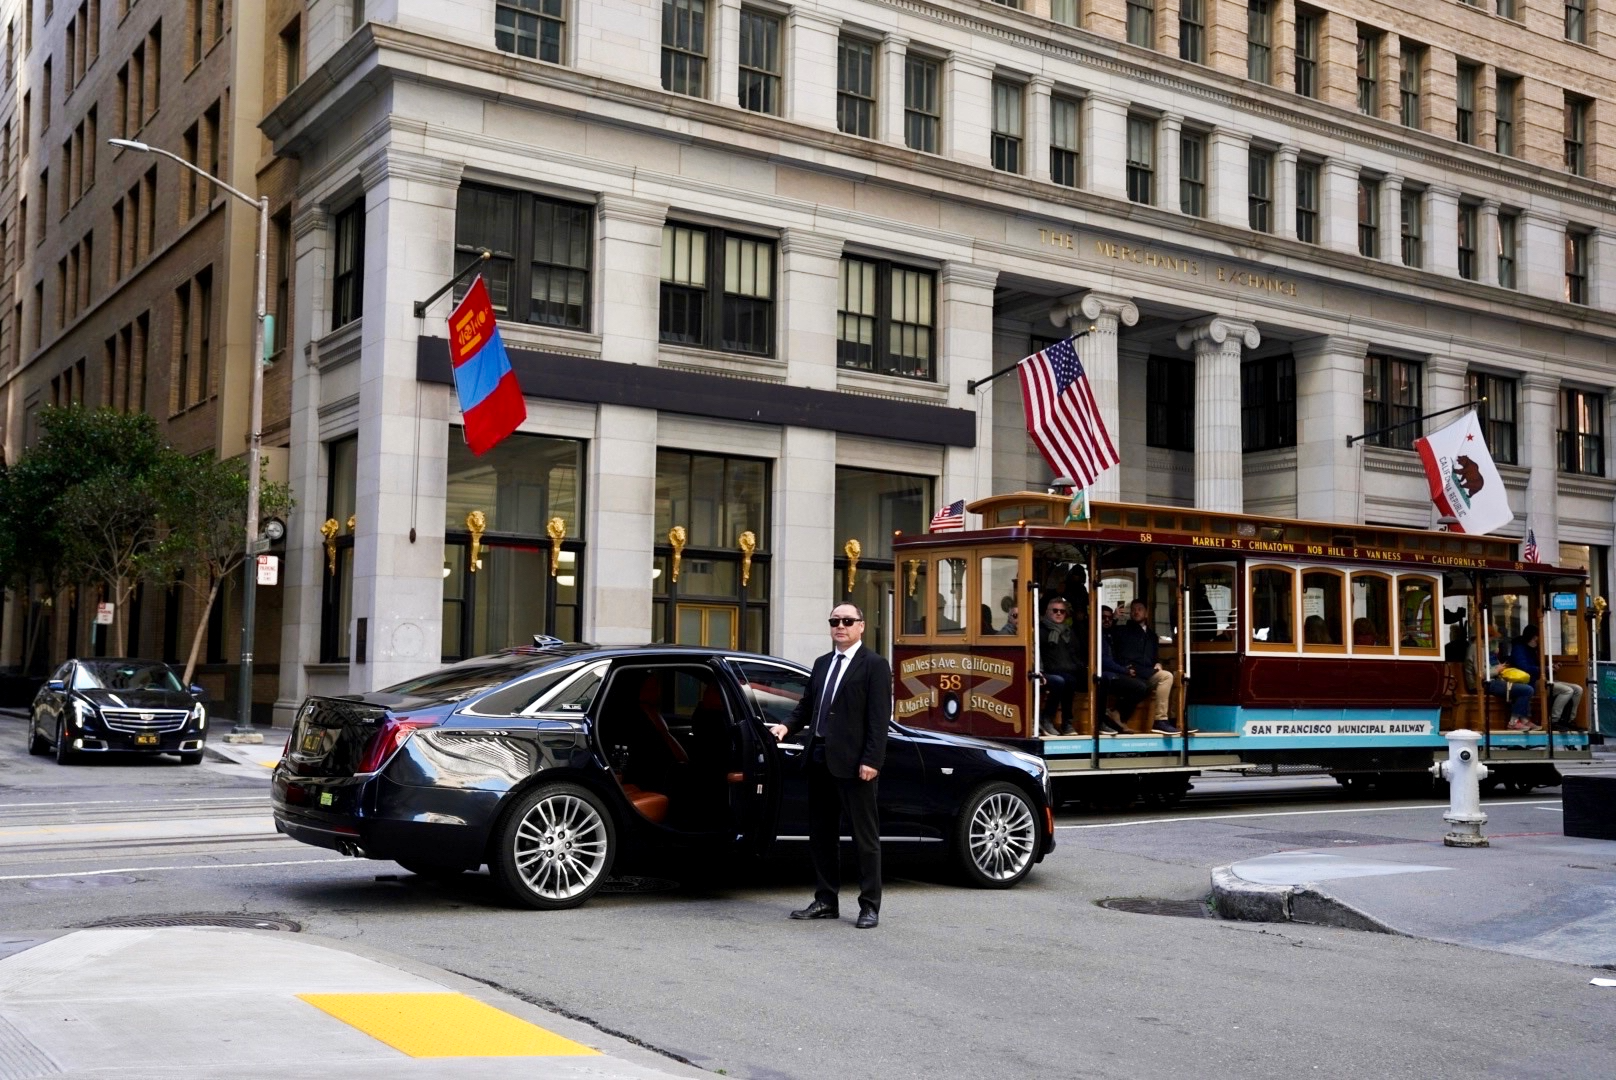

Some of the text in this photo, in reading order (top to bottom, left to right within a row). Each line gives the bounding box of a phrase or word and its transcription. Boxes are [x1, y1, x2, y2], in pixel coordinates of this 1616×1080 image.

[1038, 228, 1298, 297] THE MERCHANTS EXCHANGE
[1449, 491, 1467, 518] REPUBLIC
[1140, 533, 1152, 543] 58
[1192, 536, 1225, 548] MARKET
[1249, 540, 1294, 553] CHINATOWN
[1307, 545, 1323, 555] NOB
[1328, 546, 1346, 557] HILL
[1431, 555, 1475, 567] CALIFORNIA
[1514, 562, 1524, 571] 58
[961, 656, 1012, 677] California
[939, 674, 961, 690] 58
[898, 691, 936, 713] & Market
[971, 695, 1015, 718] Streets
[1250, 723, 1425, 735] SAN FRANCISCO MUNICIPAL RAILWAY
